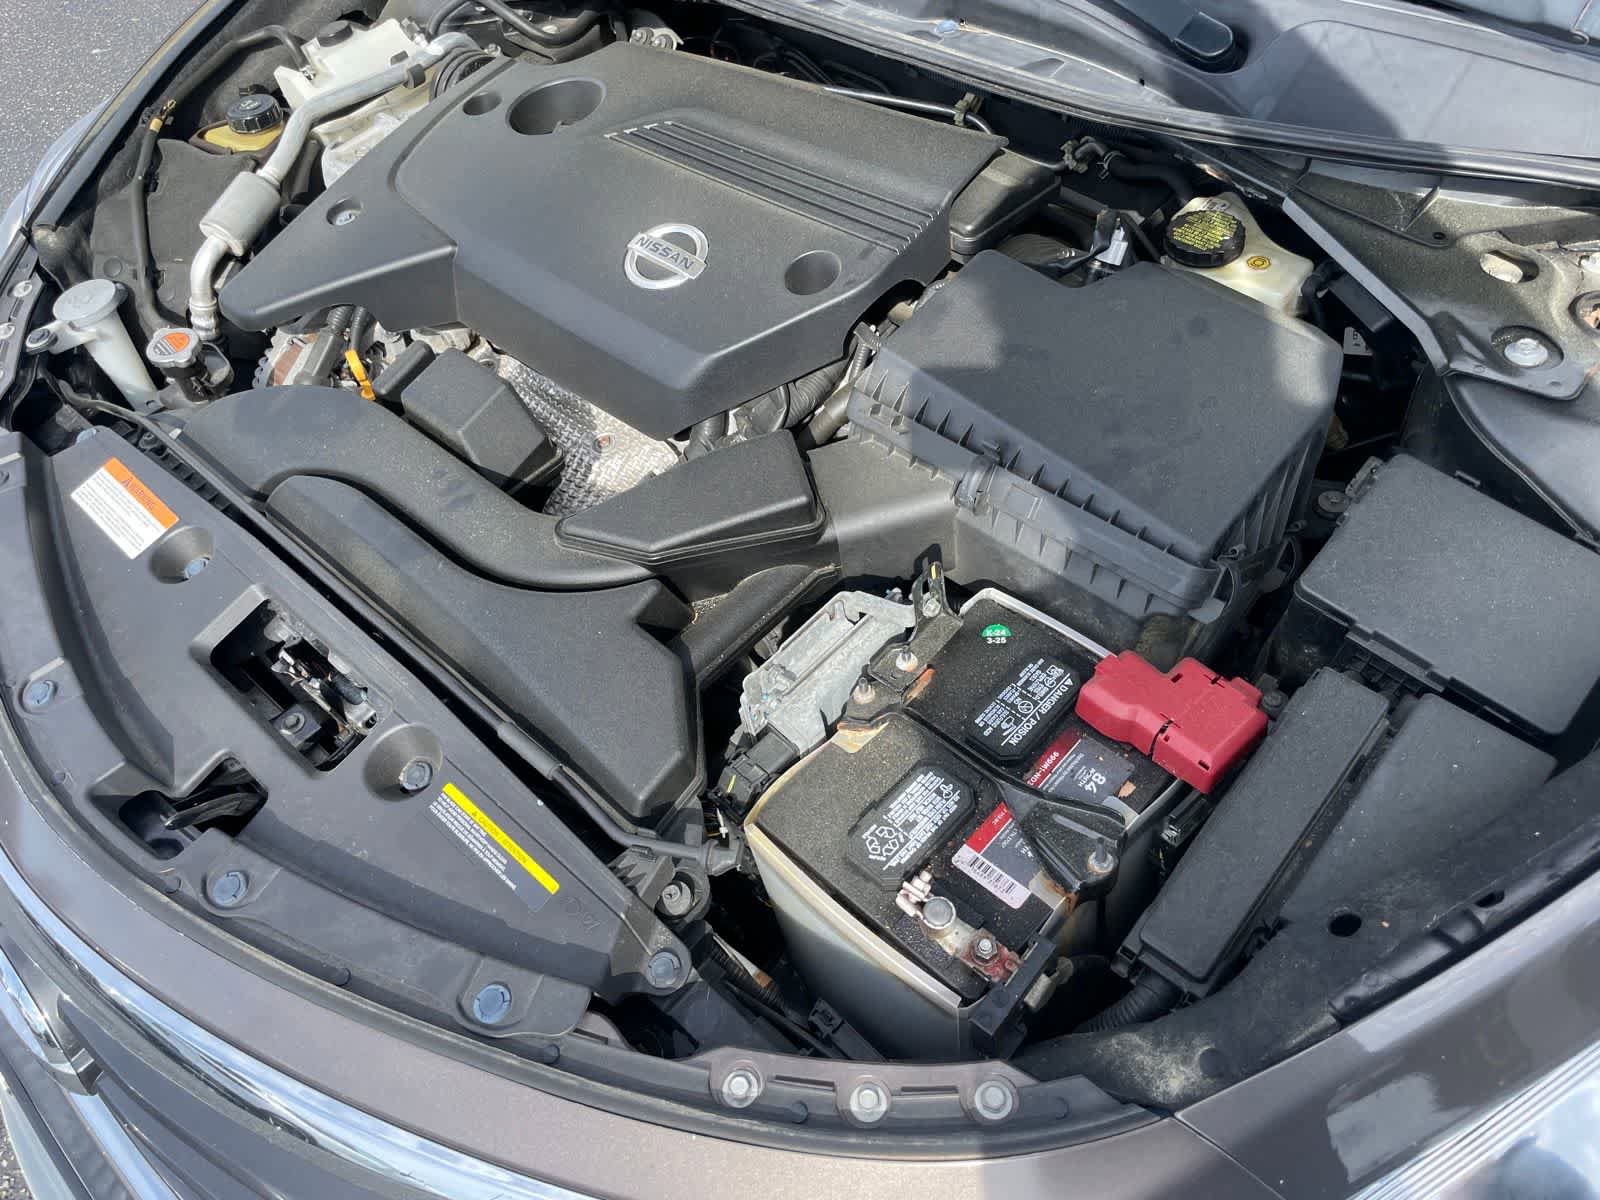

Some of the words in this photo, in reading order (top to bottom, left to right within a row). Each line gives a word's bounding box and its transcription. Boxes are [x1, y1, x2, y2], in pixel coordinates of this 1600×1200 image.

[636, 236, 694, 270] NISSAN
[1039, 685, 1069, 714] DANGER
[1009, 718, 1037, 746] POISON
[1082, 770, 1107, 796] 84
